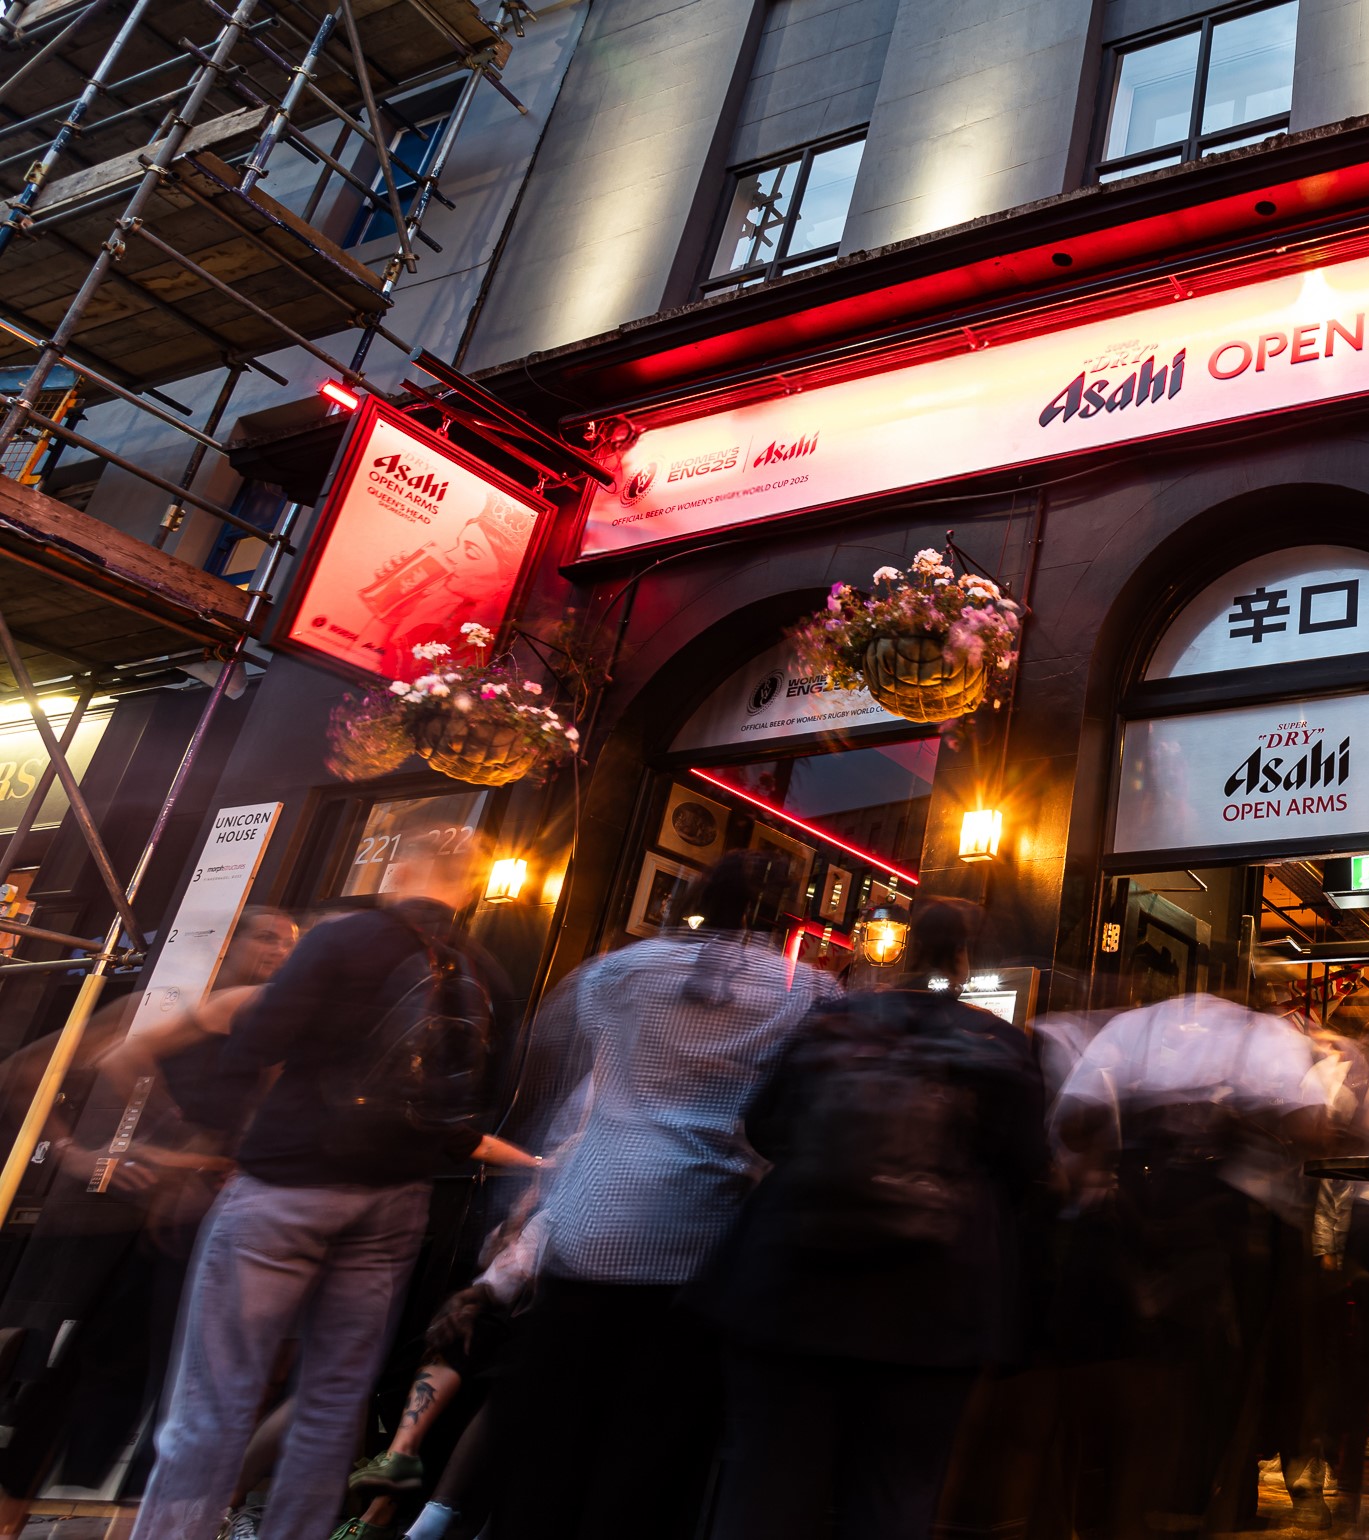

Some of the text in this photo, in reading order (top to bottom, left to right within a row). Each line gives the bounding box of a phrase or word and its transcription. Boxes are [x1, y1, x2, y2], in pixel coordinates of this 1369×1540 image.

[1207, 312, 1366, 380] OPEN
[1038, 347, 1187, 428] Asahi
[670, 447, 740, 469] WOMEN'S
[753, 430, 820, 468] Asahi
[373, 454, 449, 502] Asahi
[667, 456, 737, 482] ENG25
[367, 486, 431, 525] QUEEN'S HEAD
[369, 471, 439, 515] OPEN ARMS
[611, 474, 809, 527] OFFICIAL BEER OF WOMEN'S RUGBY WORLD CUP 2025
[1228, 578, 1359, 644] 辛口
[741, 722, 768, 732] OFFICIAL
[769, 719, 785, 728] BEER
[786, 718, 795, 726] OF
[796, 713, 827, 723] WOMEN'S
[827, 711, 849, 720] RUGBY
[850, 706, 875, 716] WORLD
[1277, 720, 1308, 731] SUPER
[1223, 735, 1350, 798] Asahi
[216, 812, 272, 829] UNICORN
[1222, 793, 1348, 822] OPEN ARMS
[216, 828, 258, 844] HOUSE
[355, 833, 402, 865] 221
[193, 869, 203, 882] 3
[168, 929, 179, 943] 2
[144, 992, 152, 1006] 1
